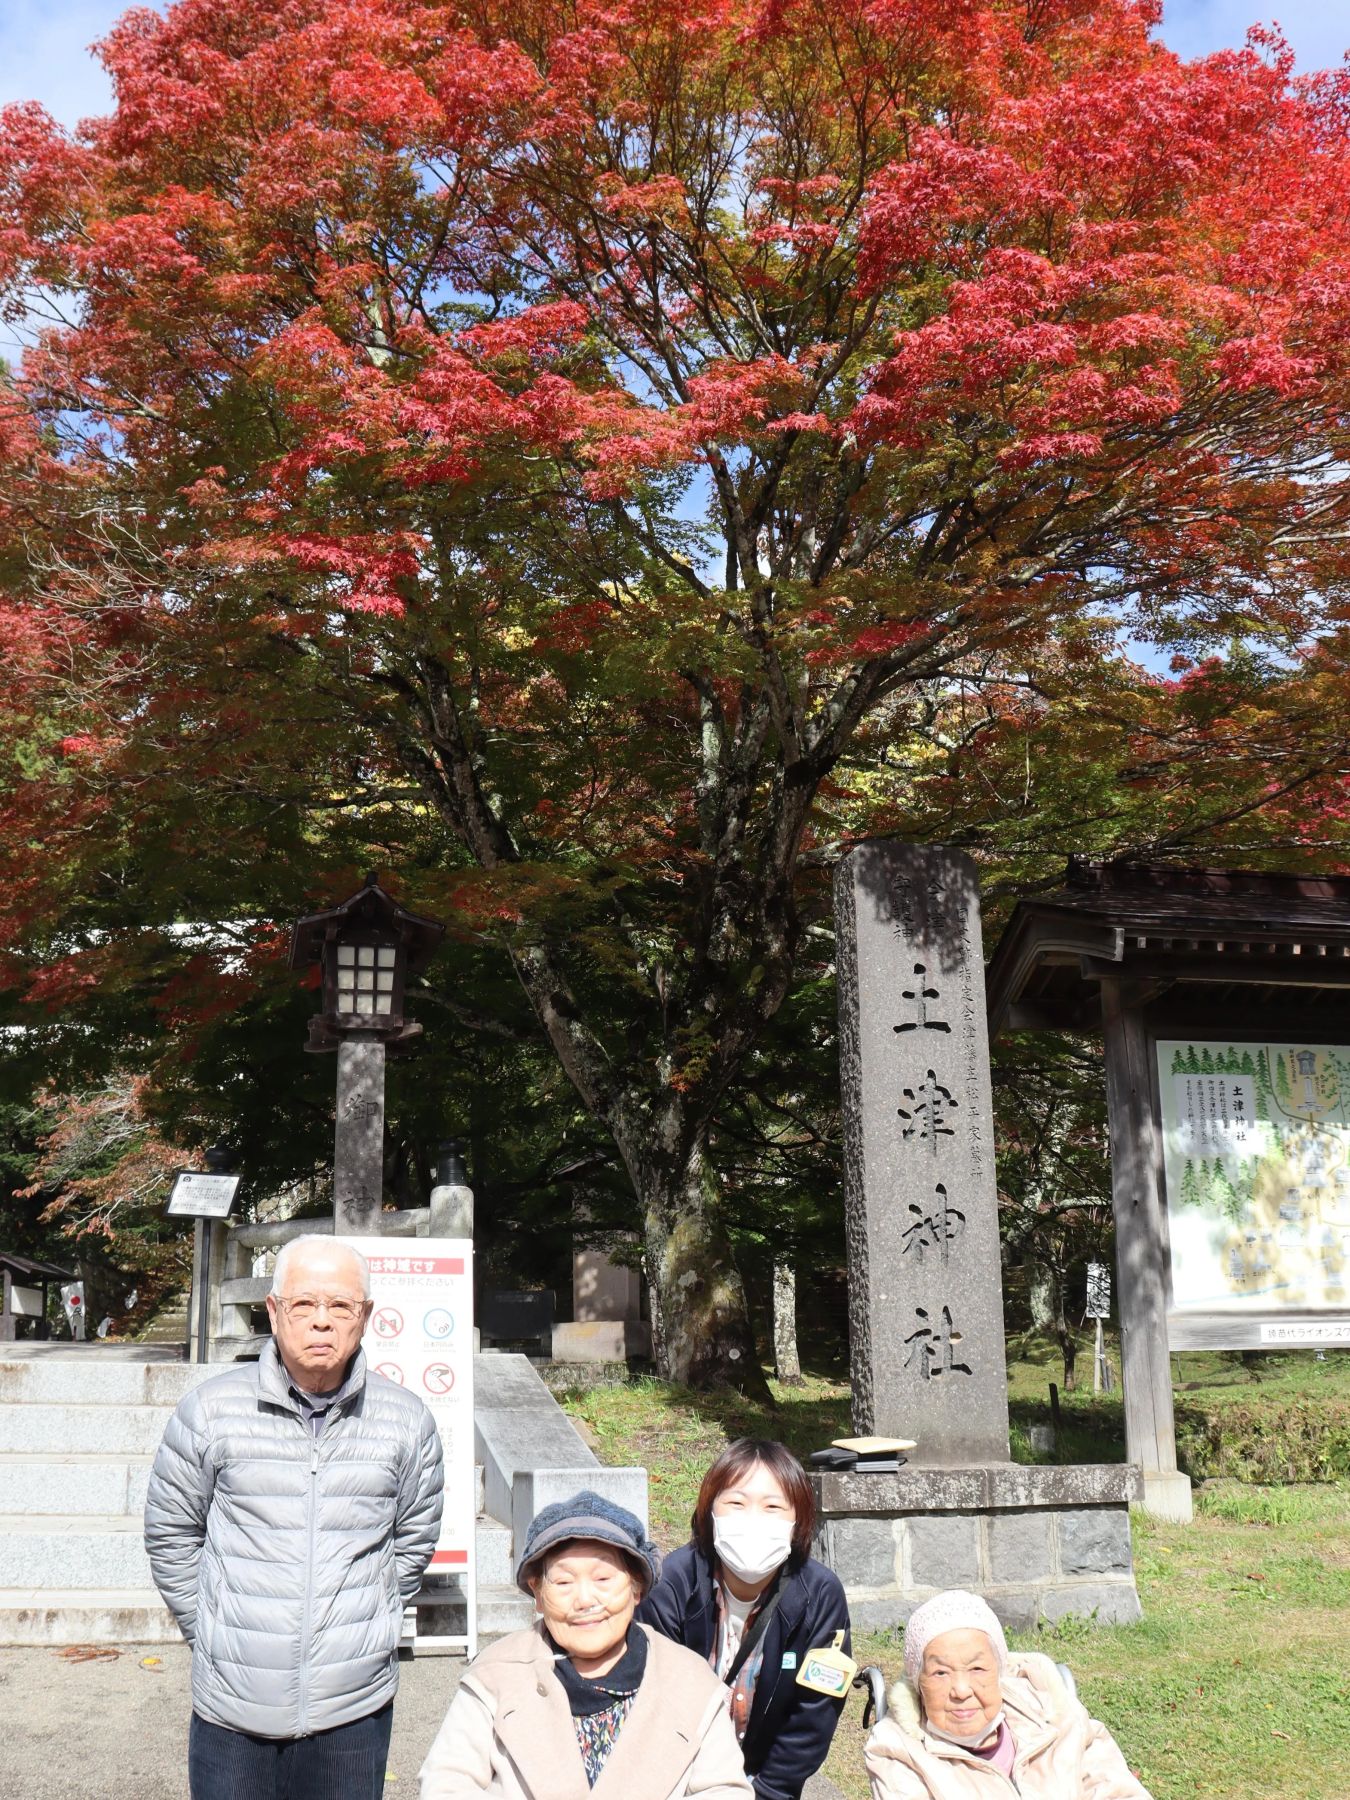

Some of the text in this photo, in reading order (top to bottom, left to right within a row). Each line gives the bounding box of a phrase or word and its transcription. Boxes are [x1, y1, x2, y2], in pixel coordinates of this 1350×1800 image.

[1232, 1086, 1246, 1141] 土津神社
[893, 963, 973, 1379] 土津神社
[368, 1258, 436, 1272] は神域です
